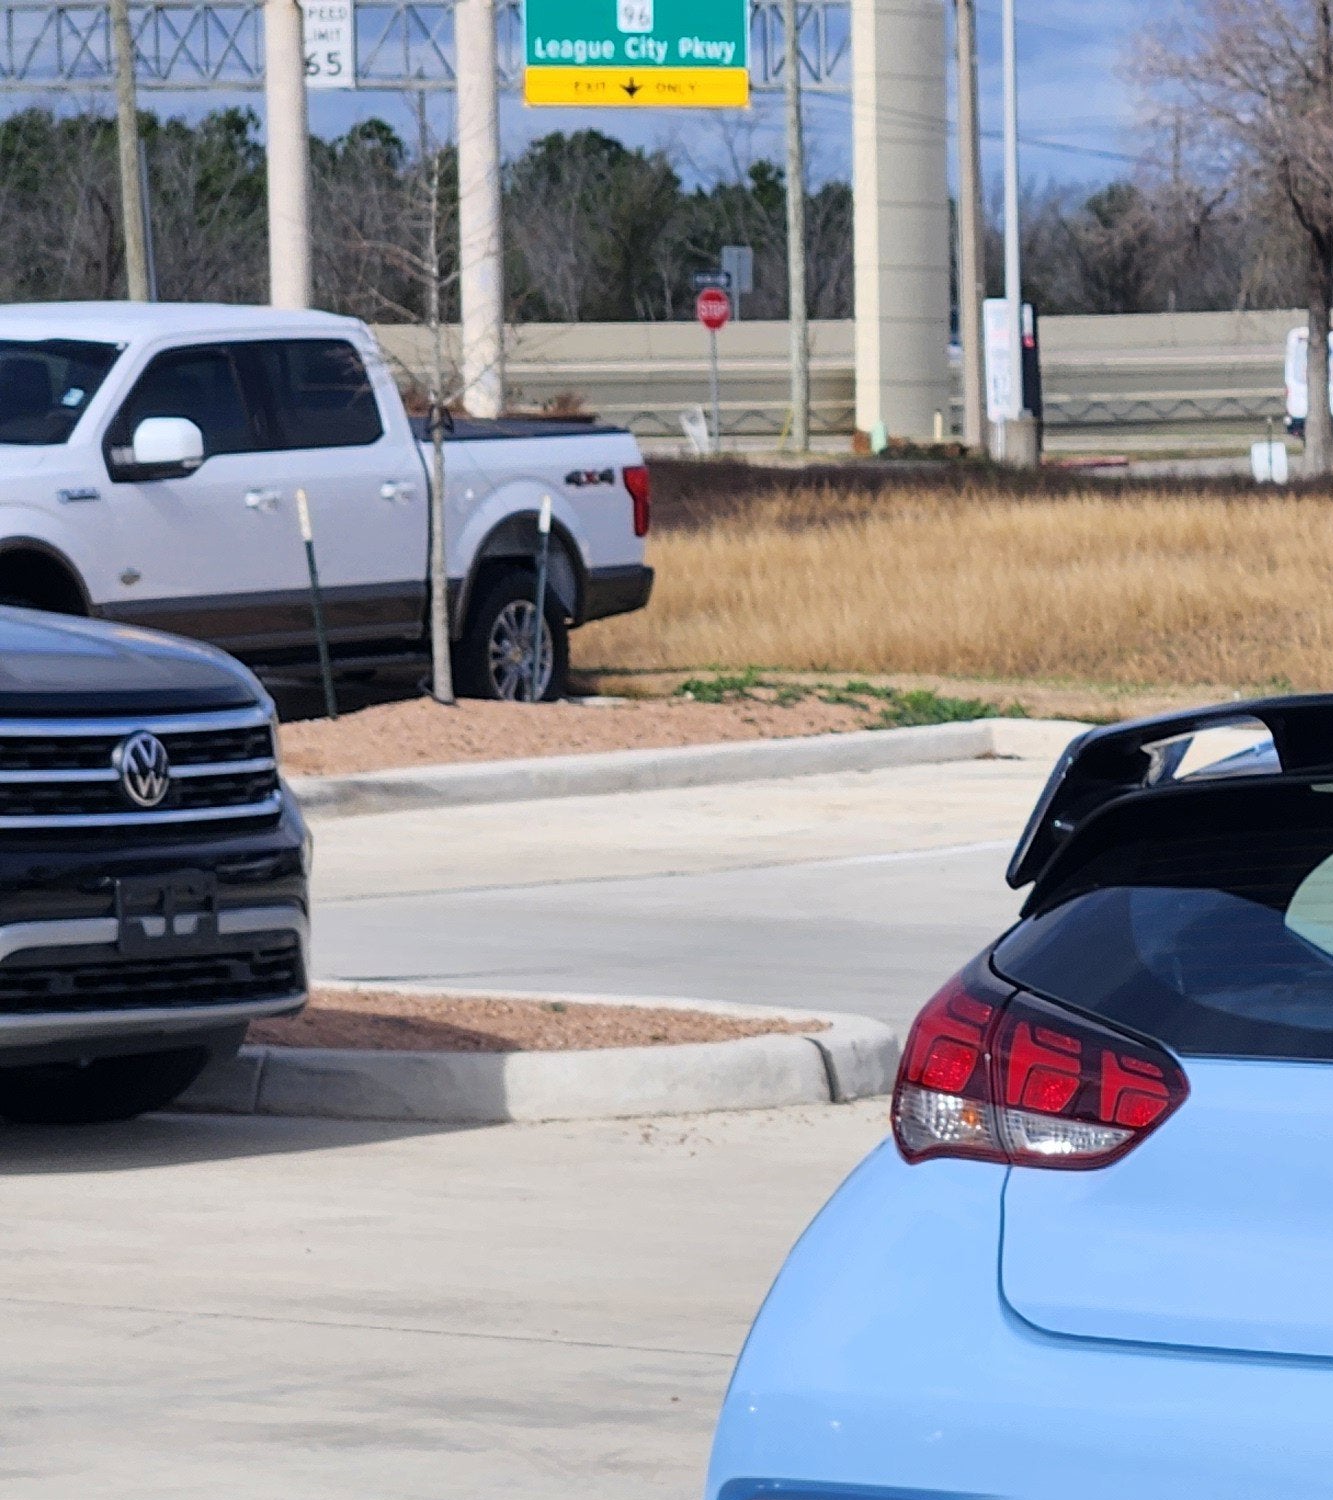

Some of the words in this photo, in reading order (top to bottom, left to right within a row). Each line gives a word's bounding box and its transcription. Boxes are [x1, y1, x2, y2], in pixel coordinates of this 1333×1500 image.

[306, 6, 347, 19] PEED
[534, 36, 615, 64] League
[624, 35, 668, 64] City
[678, 36, 736, 64] Pkwy
[304, 51, 342, 77] 65
[574, 81, 606, 94] EXIT
[656, 81, 697, 94] ONLY
[700, 301, 728, 318] STOP
